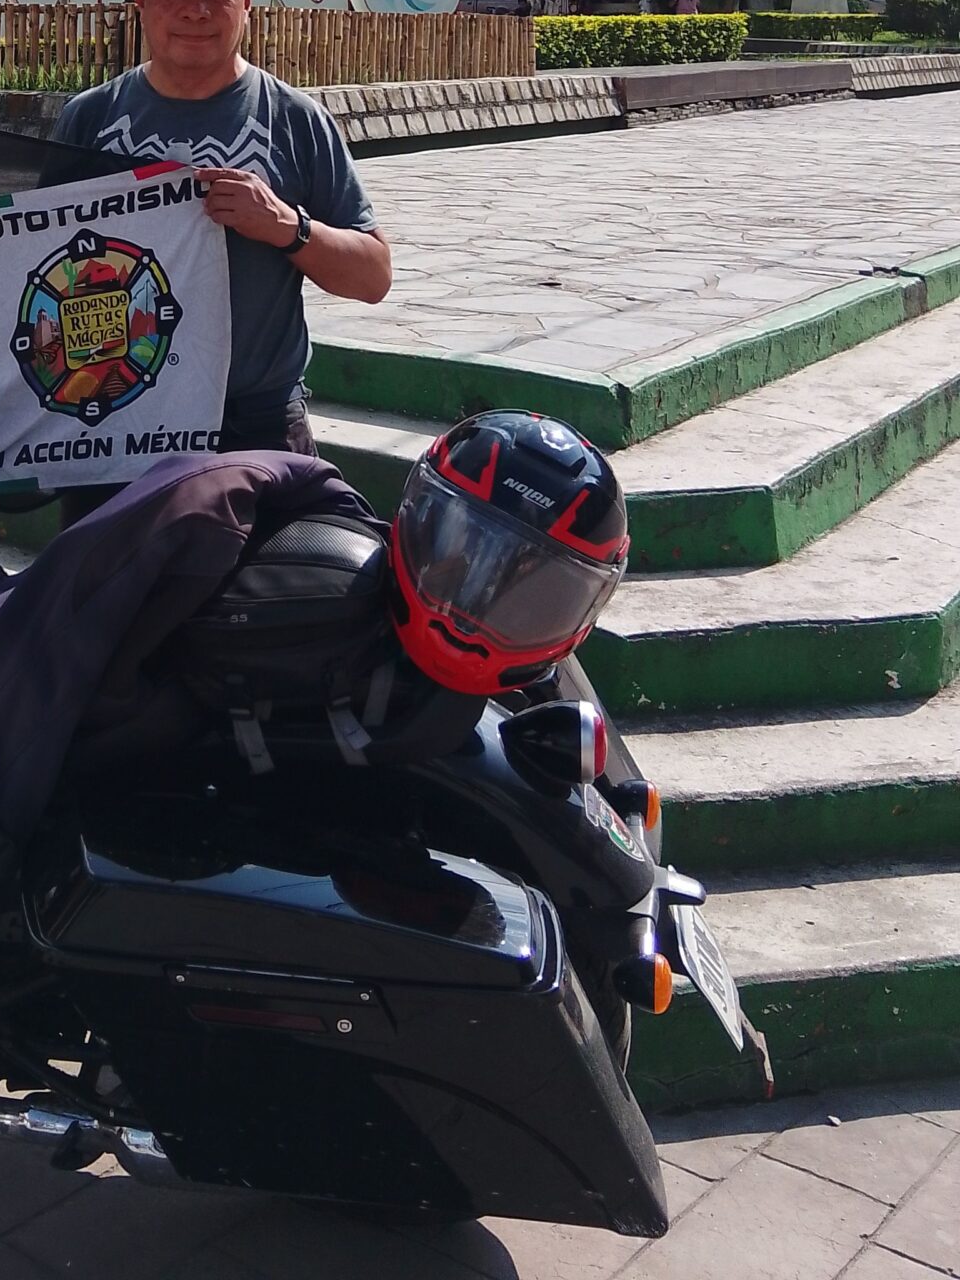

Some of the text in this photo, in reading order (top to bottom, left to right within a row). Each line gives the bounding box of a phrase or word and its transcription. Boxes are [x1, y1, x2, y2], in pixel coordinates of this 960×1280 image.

[77, 237, 96, 253] N
[160, 306, 173, 320] E
[85, 402, 100, 416] S
[13, 431, 113, 466] ACCIÓN
[125, 425, 221, 455] MÉXICO
[502, 477, 556, 509] NOLAN
